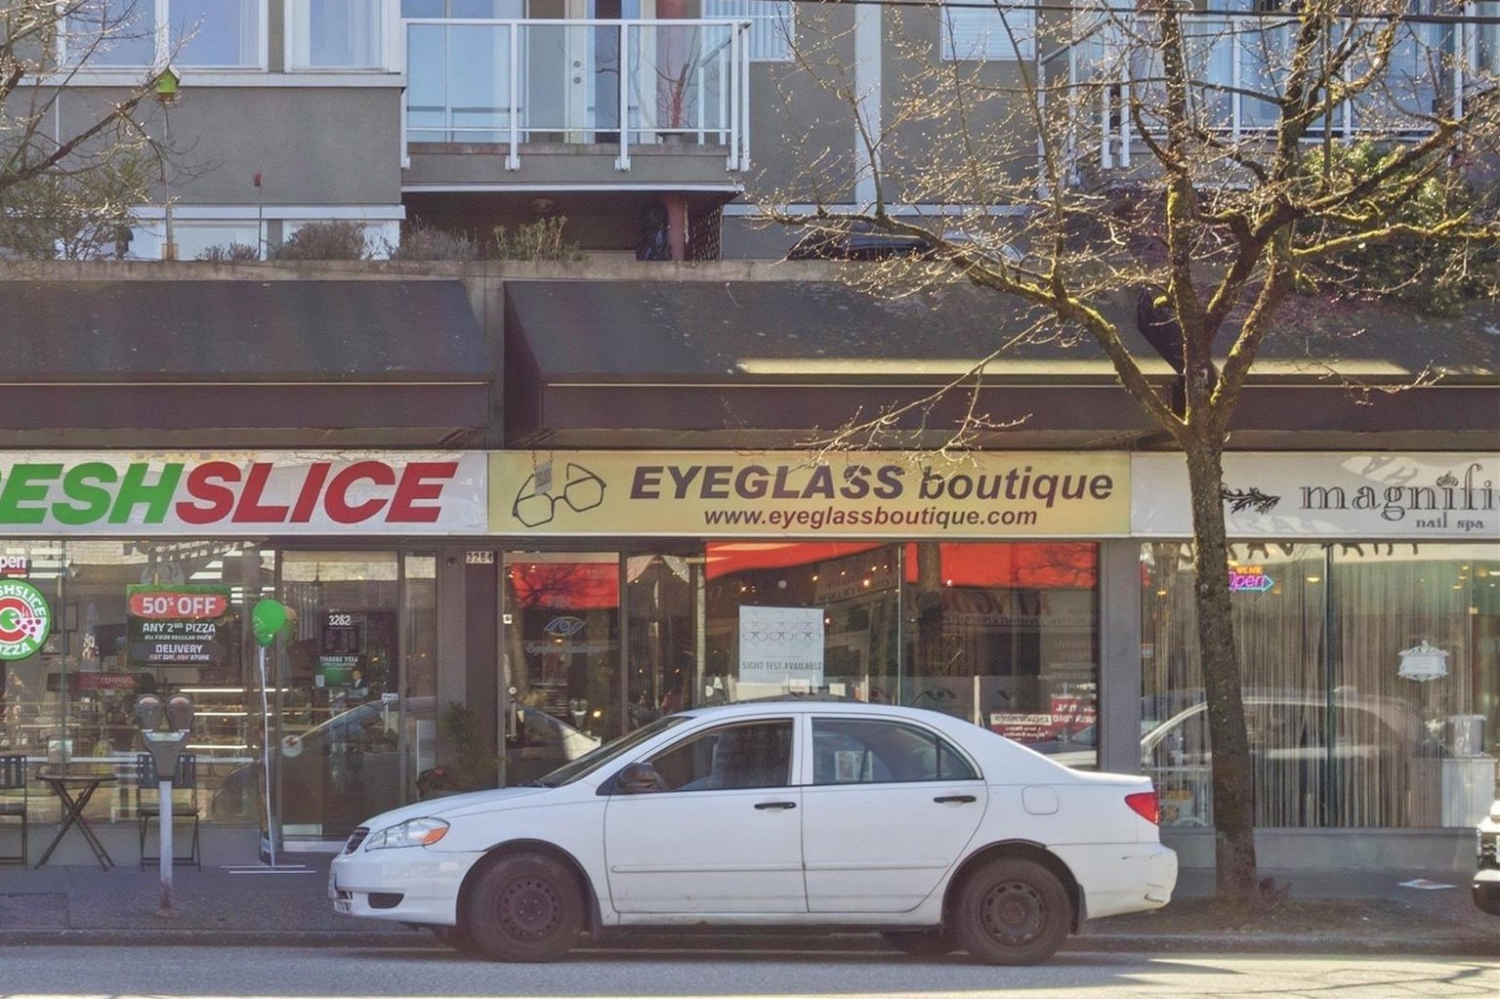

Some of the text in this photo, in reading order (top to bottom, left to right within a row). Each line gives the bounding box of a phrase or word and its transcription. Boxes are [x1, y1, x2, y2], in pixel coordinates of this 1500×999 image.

[630, 465, 1113, 508] EYEGLASS boutique
[1300, 463, 1500, 521] magnifi
[704, 506, 1037, 529] www.eyeglassboutique.com
[1416, 512, 1485, 532] nail spa
[177, 597, 217, 614] OFF
[143, 623, 165, 633] ANY
[185, 623, 216, 633] PIZZA
[155, 644, 203, 654] DELIVERY
